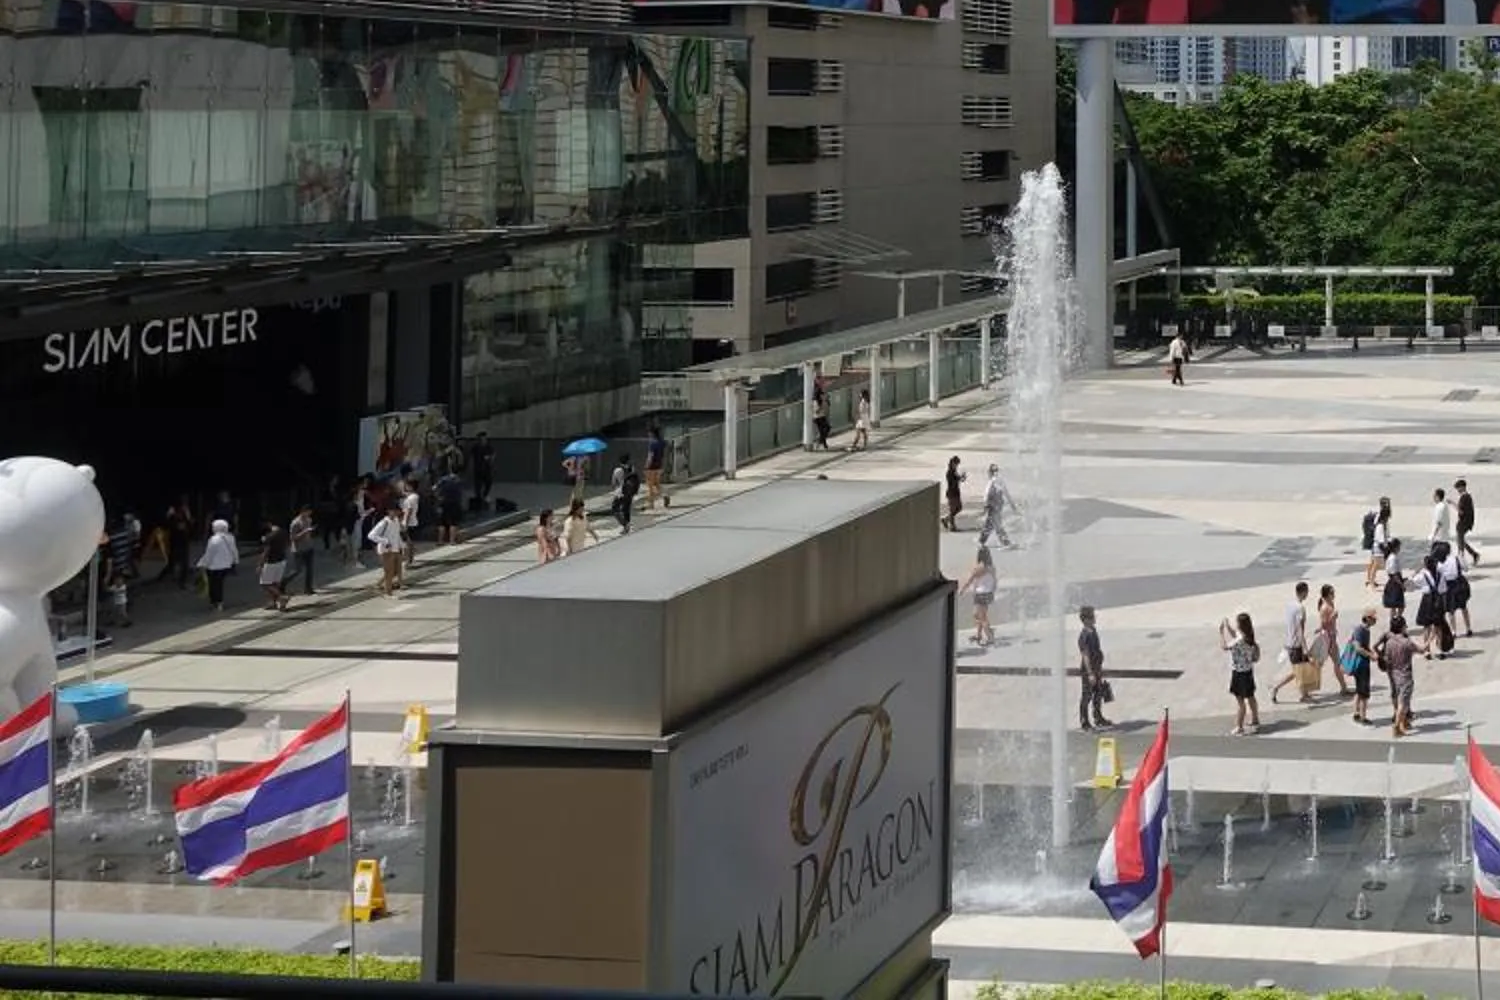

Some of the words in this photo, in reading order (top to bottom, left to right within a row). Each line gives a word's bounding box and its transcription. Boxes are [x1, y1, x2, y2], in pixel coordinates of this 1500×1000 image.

[42, 323, 132, 373] SIAM
[140, 308, 259, 355] CENTER
[792, 780, 937, 948] PARAGON
